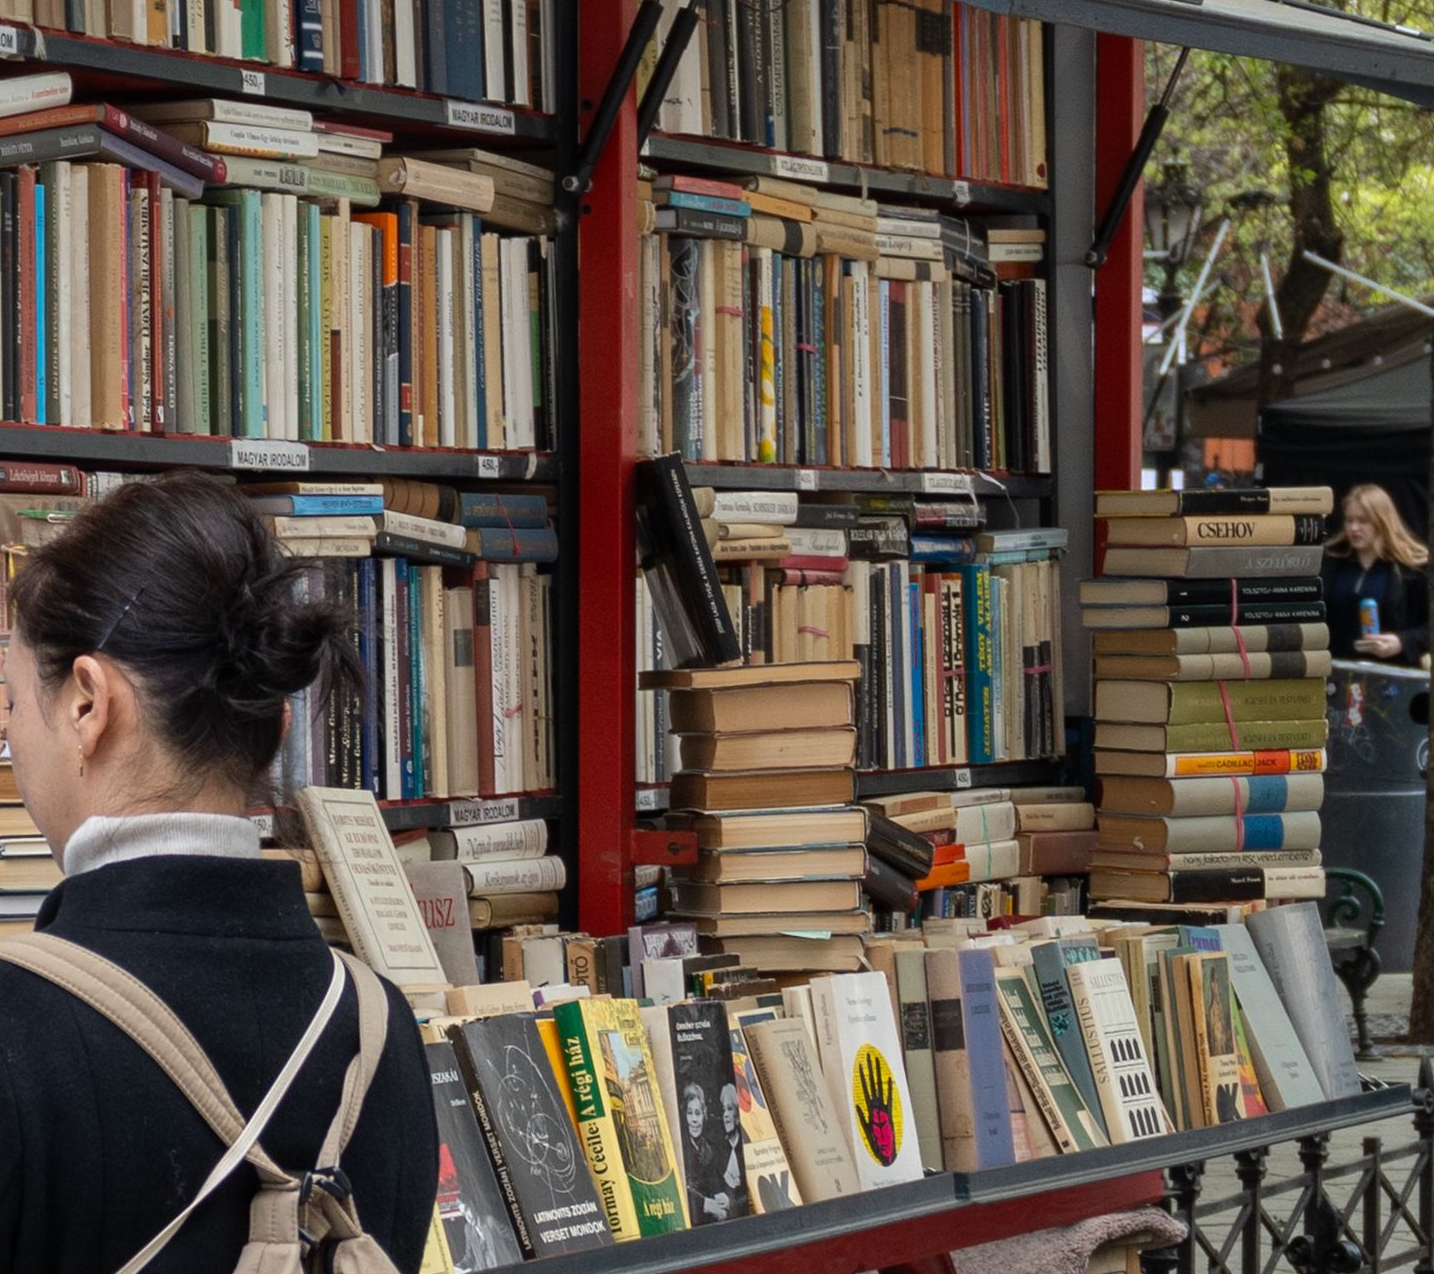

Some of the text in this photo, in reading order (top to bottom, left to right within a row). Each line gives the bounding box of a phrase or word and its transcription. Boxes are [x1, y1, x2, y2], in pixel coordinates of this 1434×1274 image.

[452, 108, 513, 130] MAGYAR IRODALOM
[237, 451, 306, 467] MAGYAR IRODALOM
[1197, 522, 1255, 539] CSEHOV
[454, 803, 516, 822] MAGYAR IRODALOM
[1078, 998, 1109, 1084] SALLUSTIUS
[569, 1036, 597, 1116] A régi ház
[533, 1201, 598, 1224] LATINOVITS ZOLTÁN
[540, 1221, 607, 1244] VERSET MONDOK
